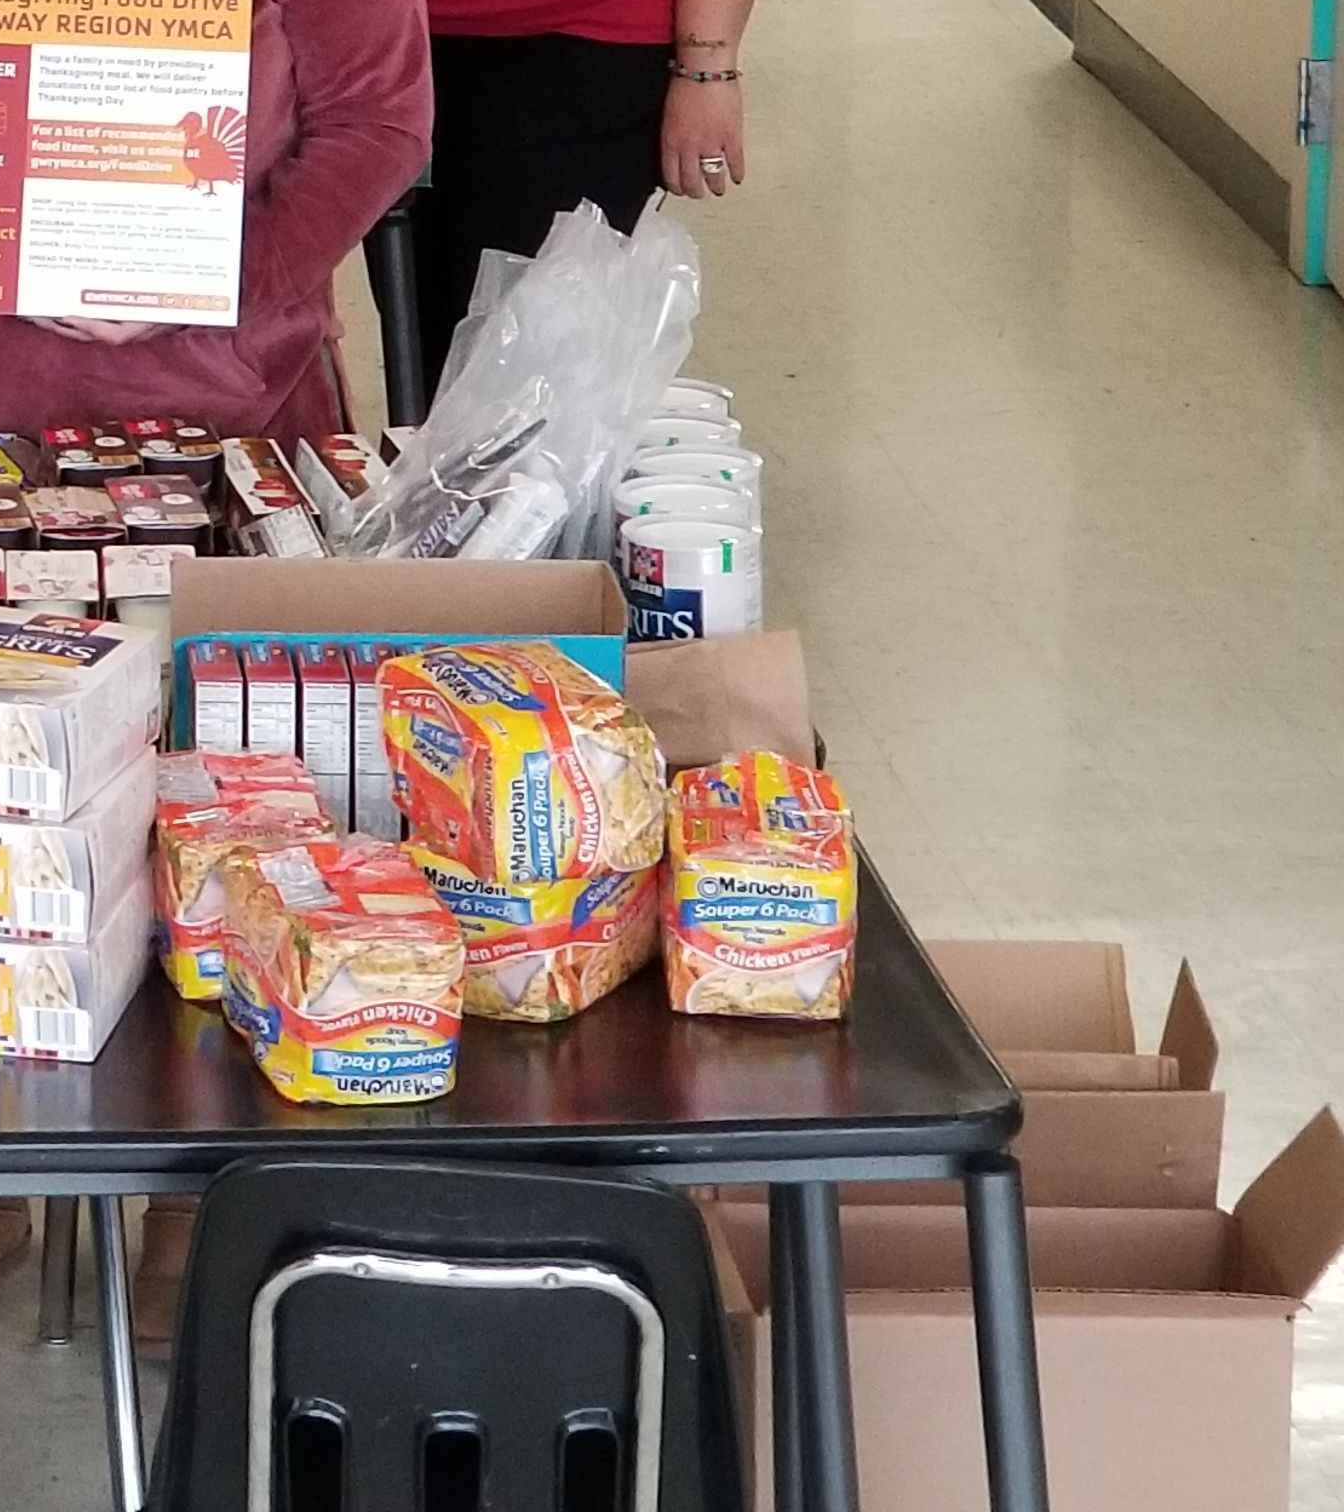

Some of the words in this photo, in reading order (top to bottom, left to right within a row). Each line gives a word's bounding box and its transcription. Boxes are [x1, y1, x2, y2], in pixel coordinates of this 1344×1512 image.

[56, 13, 153, 38] REGION
[162, 19, 234, 41] YMCA
[39, 54, 61, 66] Help
[73, 55, 103, 67] family
[117, 57, 141, 67] need
[144, 58, 156, 70] by
[158, 60, 205, 72] providing
[39, 67, 104, 80] Thanksgiving
[153, 71, 171, 80] will
[173, 72, 207, 82] deliver
[38, 80, 88, 91] donations
[91, 82, 101, 91] to
[104, 83, 121, 92] our
[123, 83, 147, 93] local
[150, 85, 172, 95] food
[175, 86, 208, 97] pantry
[211, 87, 244, 98] before
[38, 93, 103, 106] Thanksgiving
[32, 123, 52, 136] For
[64, 125, 84, 137] list
[87, 126, 100, 137] of
[102, 128, 186, 142] recommended
[31, 141, 60, 152] food
[102, 143, 129, 155] visit
[131, 147, 145, 156] us
[147, 146, 184, 158] online
[186, 149, 201, 158] at
[532, 769, 550, 813] Pack
[510, 777, 526, 871] Maruchan
[576, 789, 599, 864] Chicken
[719, 876, 813, 899] Maruchan
[460, 898, 471, 913] 6
[474, 902, 513, 919] Pack
[694, 903, 759, 919] Souper
[760, 901, 774, 917] 6
[775, 903, 817, 921] Pack
[714, 944, 791, 969] Chicken
[362, 1004, 438, 1027] Chicken
[377, 1052, 391, 1072] 6
[395, 1050, 453, 1071] Souper
[335, 1076, 430, 1098] Maruchan
